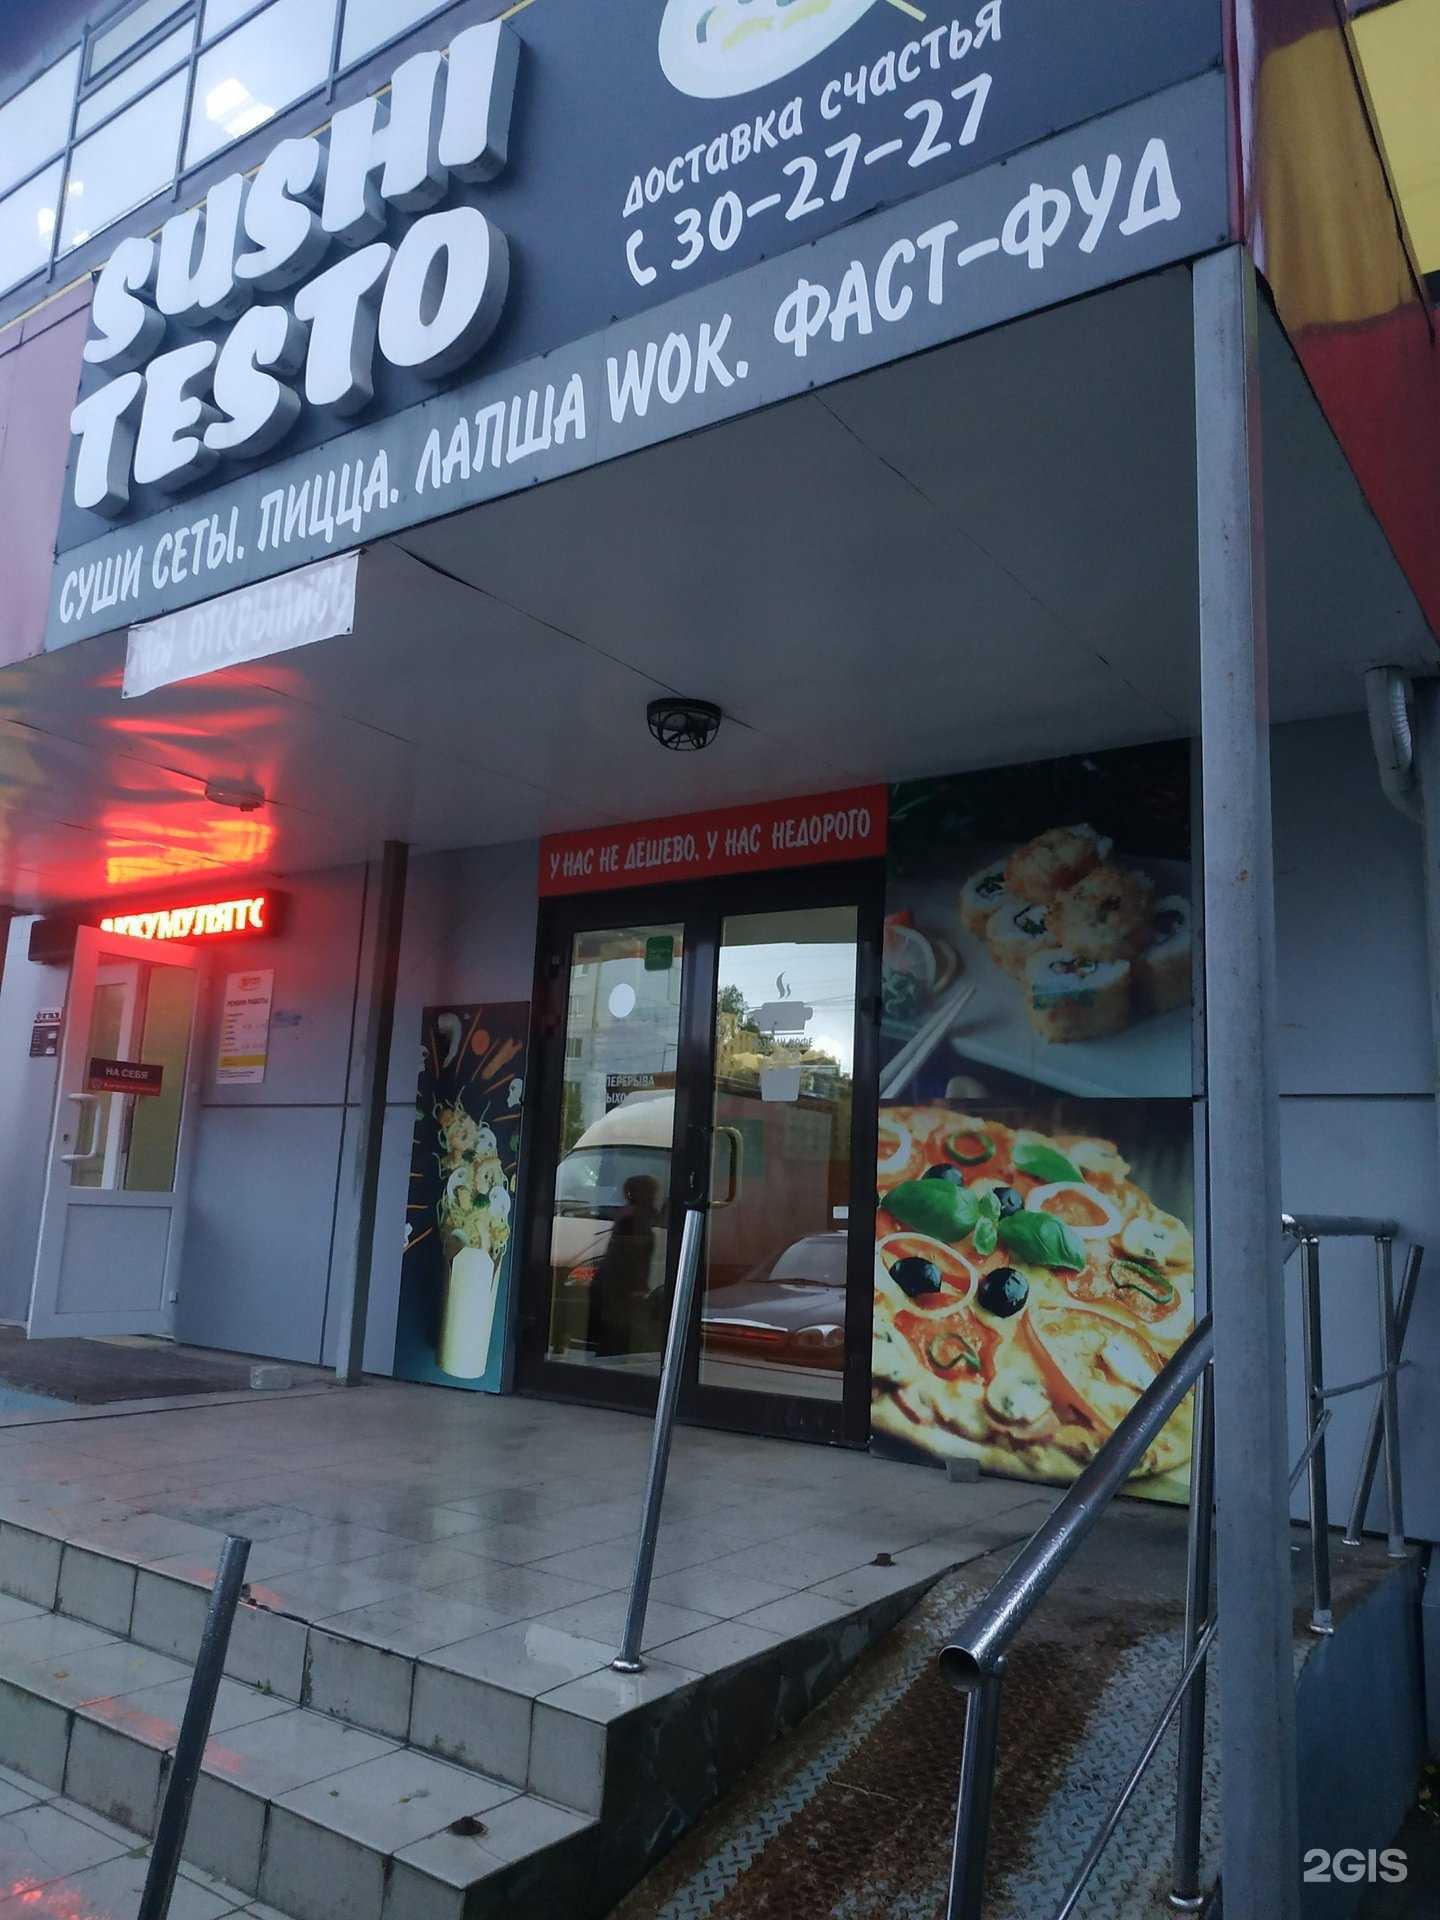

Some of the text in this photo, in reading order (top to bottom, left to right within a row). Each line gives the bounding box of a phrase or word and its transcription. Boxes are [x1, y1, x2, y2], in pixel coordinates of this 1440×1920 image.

[83, 20, 516, 368] SUSHI
[671, 73, 993, 271] 30-27-27
[59, 137, 1182, 624] СУШИ СЕТЫ. ПИЦЦА. ЛАПША WOK. ФАСТ-ФУД
[70, 206, 502, 513] TESTO
[549, 851, 562, 881] У
[562, 847, 595, 878] НАС
[599, 845, 620, 873] НЕ
[706, 830, 719, 860] У
[725, 823, 762, 857] НАС
[771, 806, 872, 850] НЕДОРОГО
[105, 1067, 120, 1077] НА
